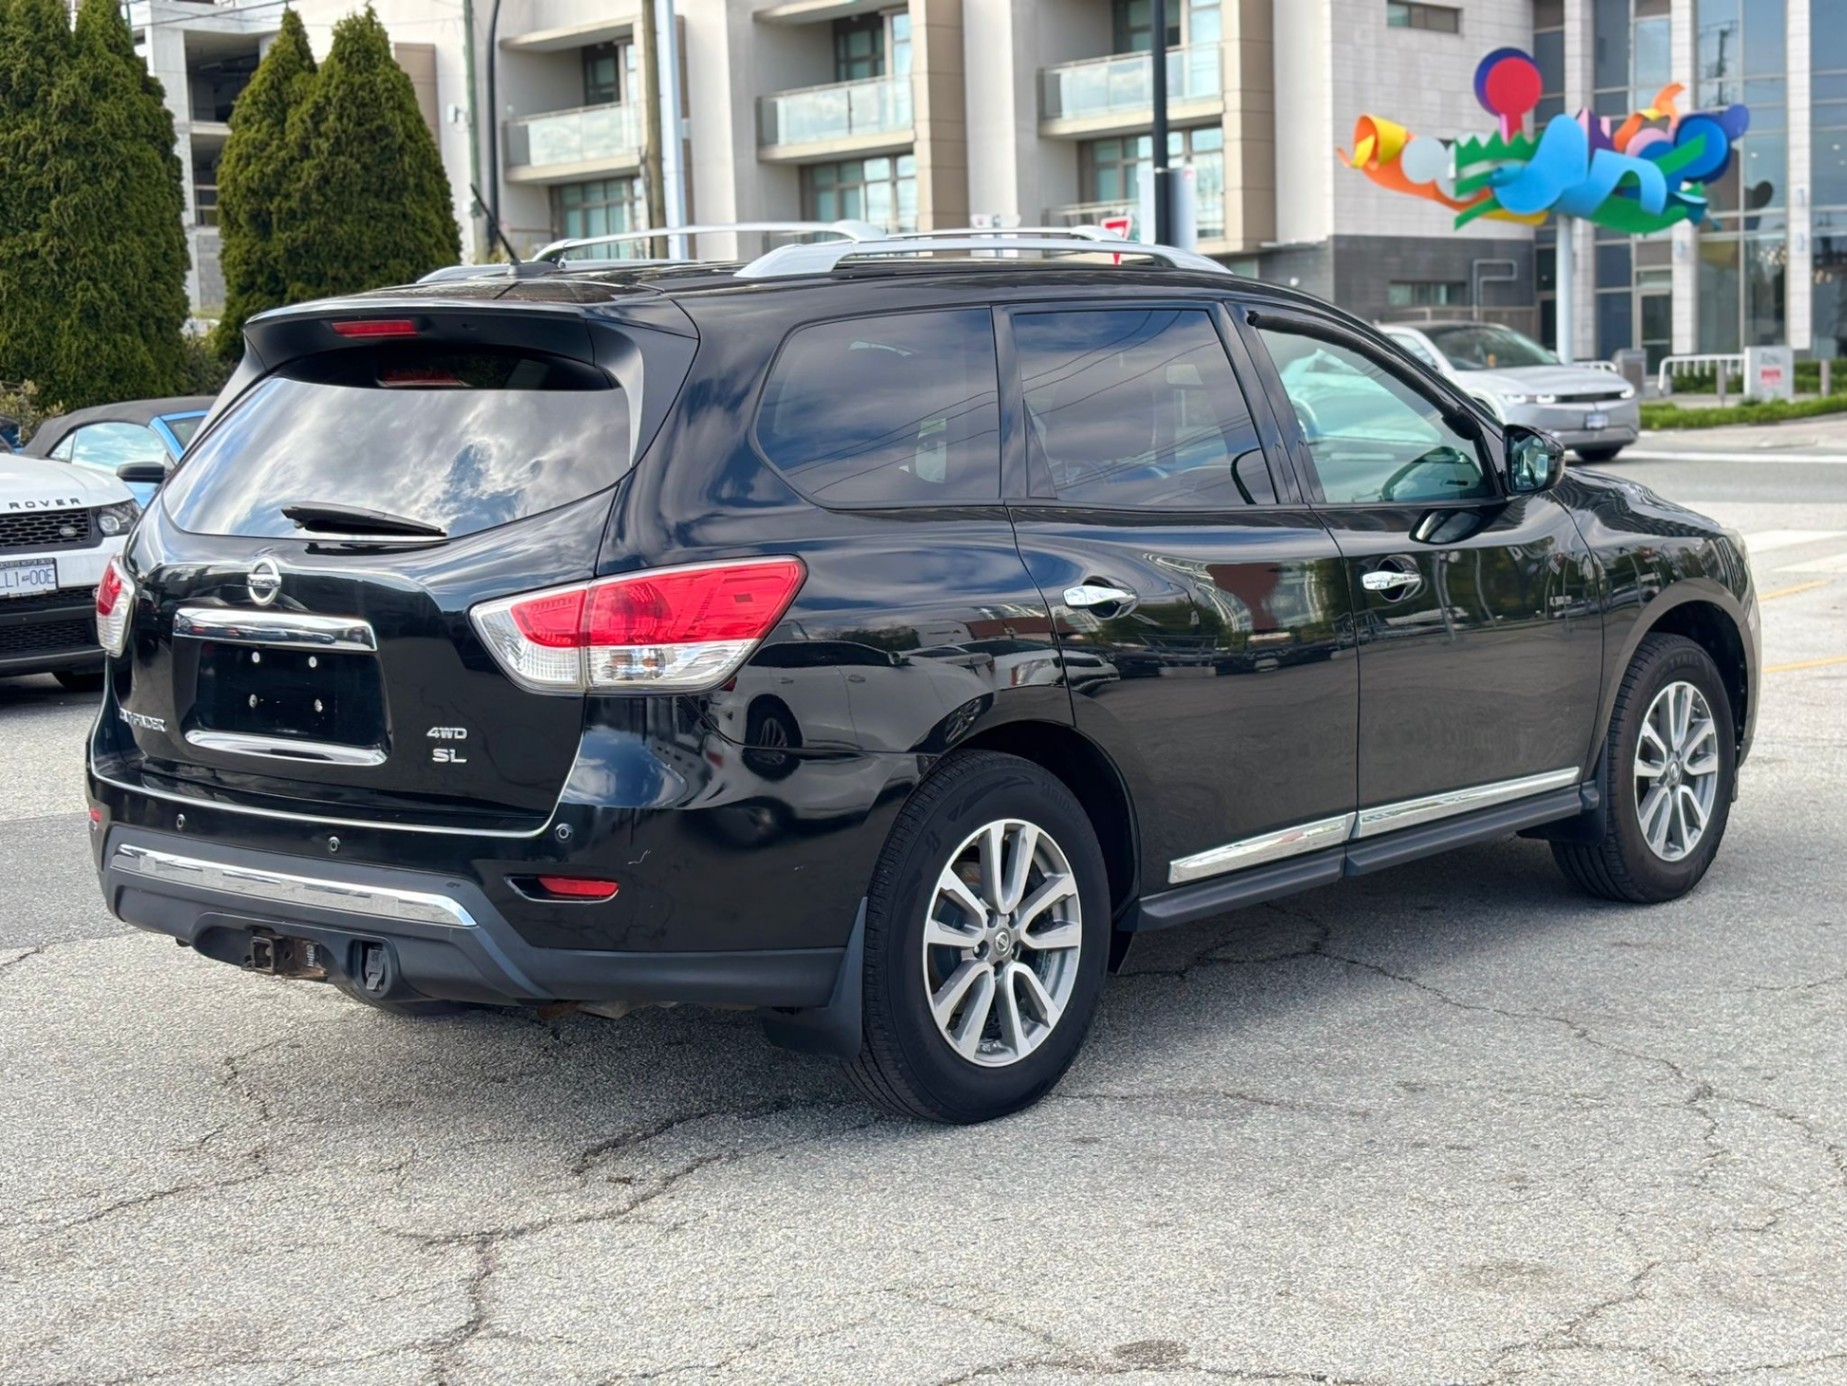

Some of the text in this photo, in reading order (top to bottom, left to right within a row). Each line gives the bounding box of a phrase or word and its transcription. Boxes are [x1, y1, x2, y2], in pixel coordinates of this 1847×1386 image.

[9, 497, 82, 510] ROVER
[426, 726, 468, 740] 4WD
[432, 748, 468, 763] SL
